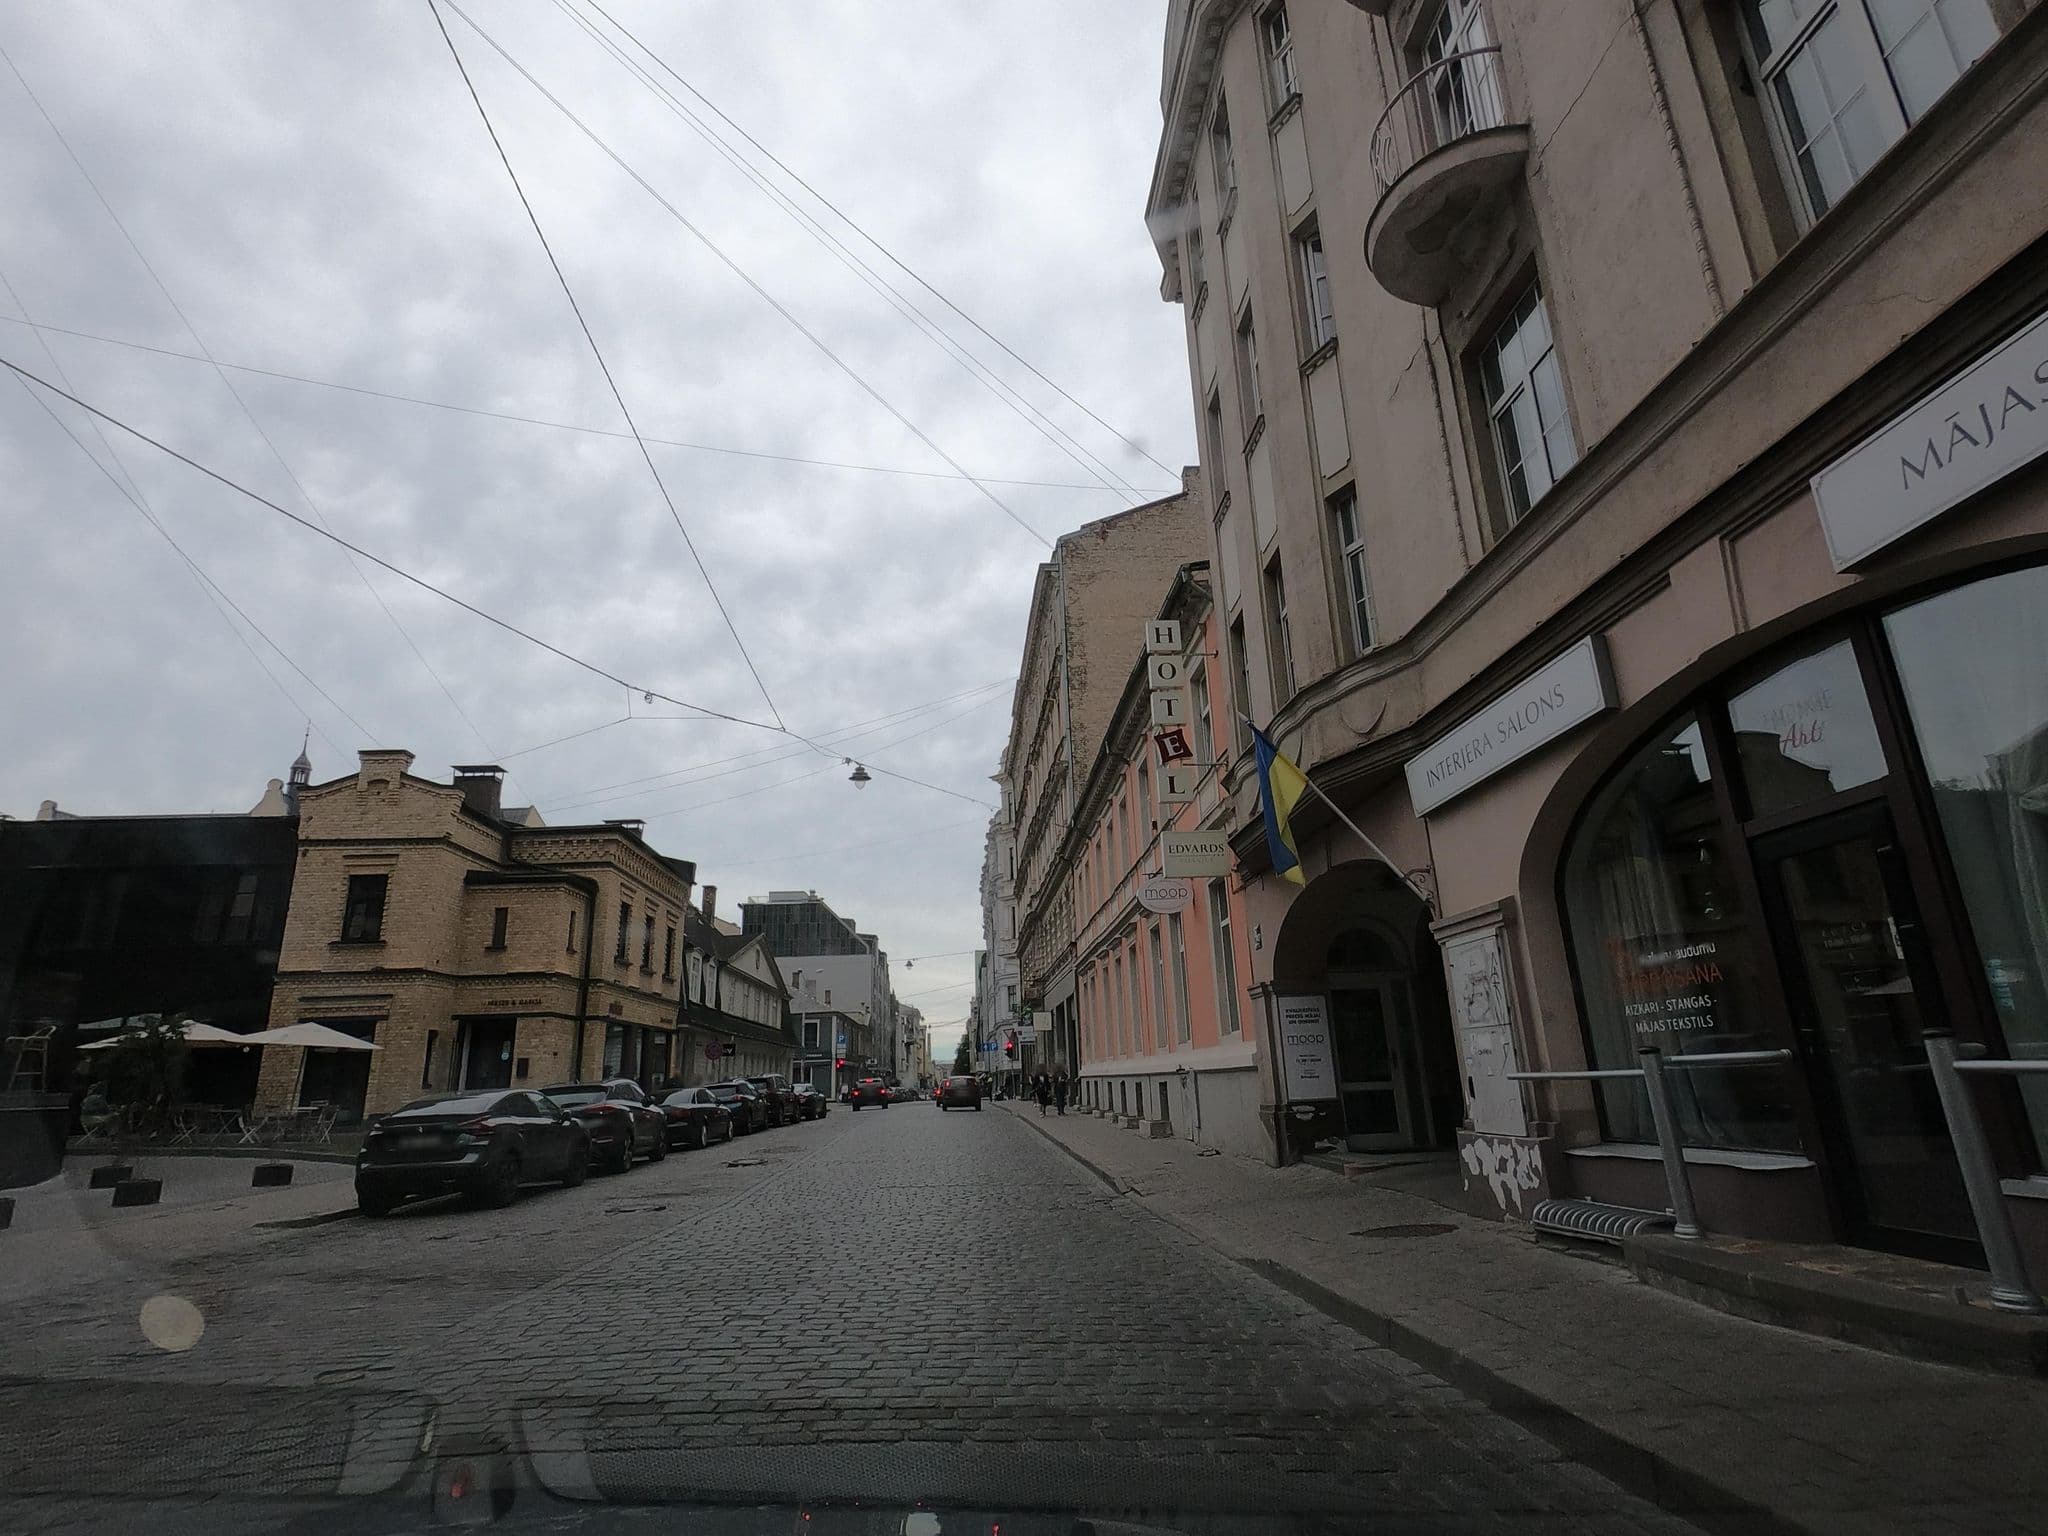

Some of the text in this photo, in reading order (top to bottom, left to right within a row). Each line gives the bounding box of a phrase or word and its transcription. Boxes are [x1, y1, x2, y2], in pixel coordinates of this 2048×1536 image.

[1154, 627, 1185, 794] HOTEL
[1426, 683, 1564, 788] INTERJERA SALONS
[1168, 844, 1225, 854] EDVARDS
[1144, 887, 1188, 899] moop
[1625, 1001, 1659, 1016] AIZKARI
[1665, 994, 1712, 1011] STANGAS
[1666, 1014, 1714, 1030] TEKSTILS
[838, 1035, 845, 1043] P
[1287, 1034, 1324, 1046] moop
